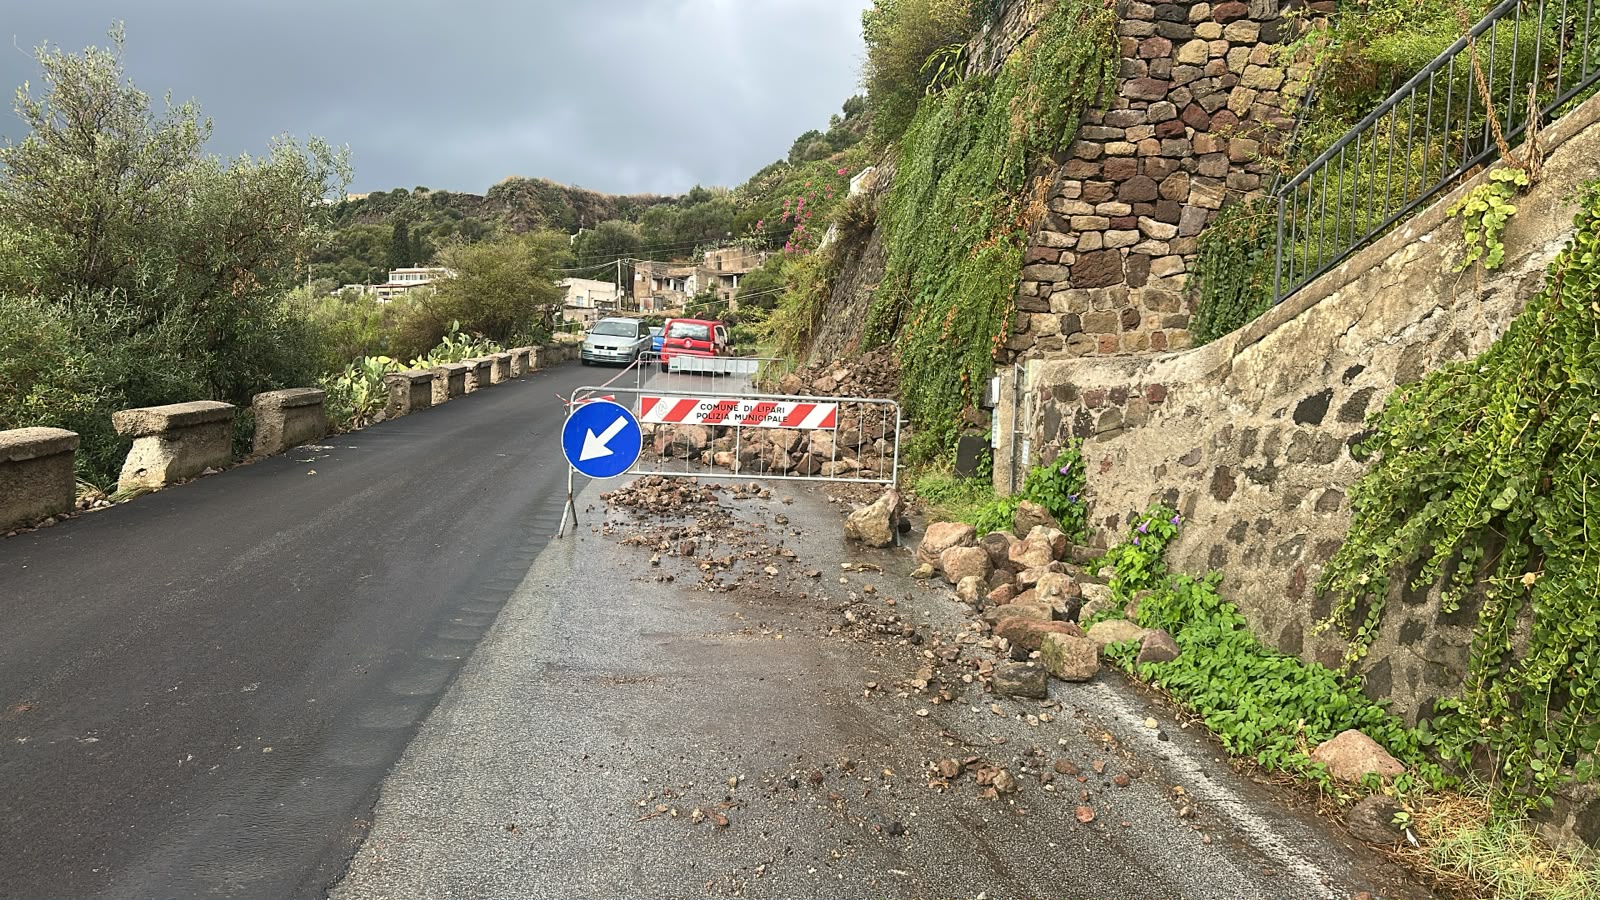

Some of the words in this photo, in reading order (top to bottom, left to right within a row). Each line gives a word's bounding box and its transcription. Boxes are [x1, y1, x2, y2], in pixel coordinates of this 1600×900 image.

[700, 403, 738, 412] COMUNE
[757, 405, 785, 414] LIPARI
[734, 414, 788, 422] MUNICIPALE
